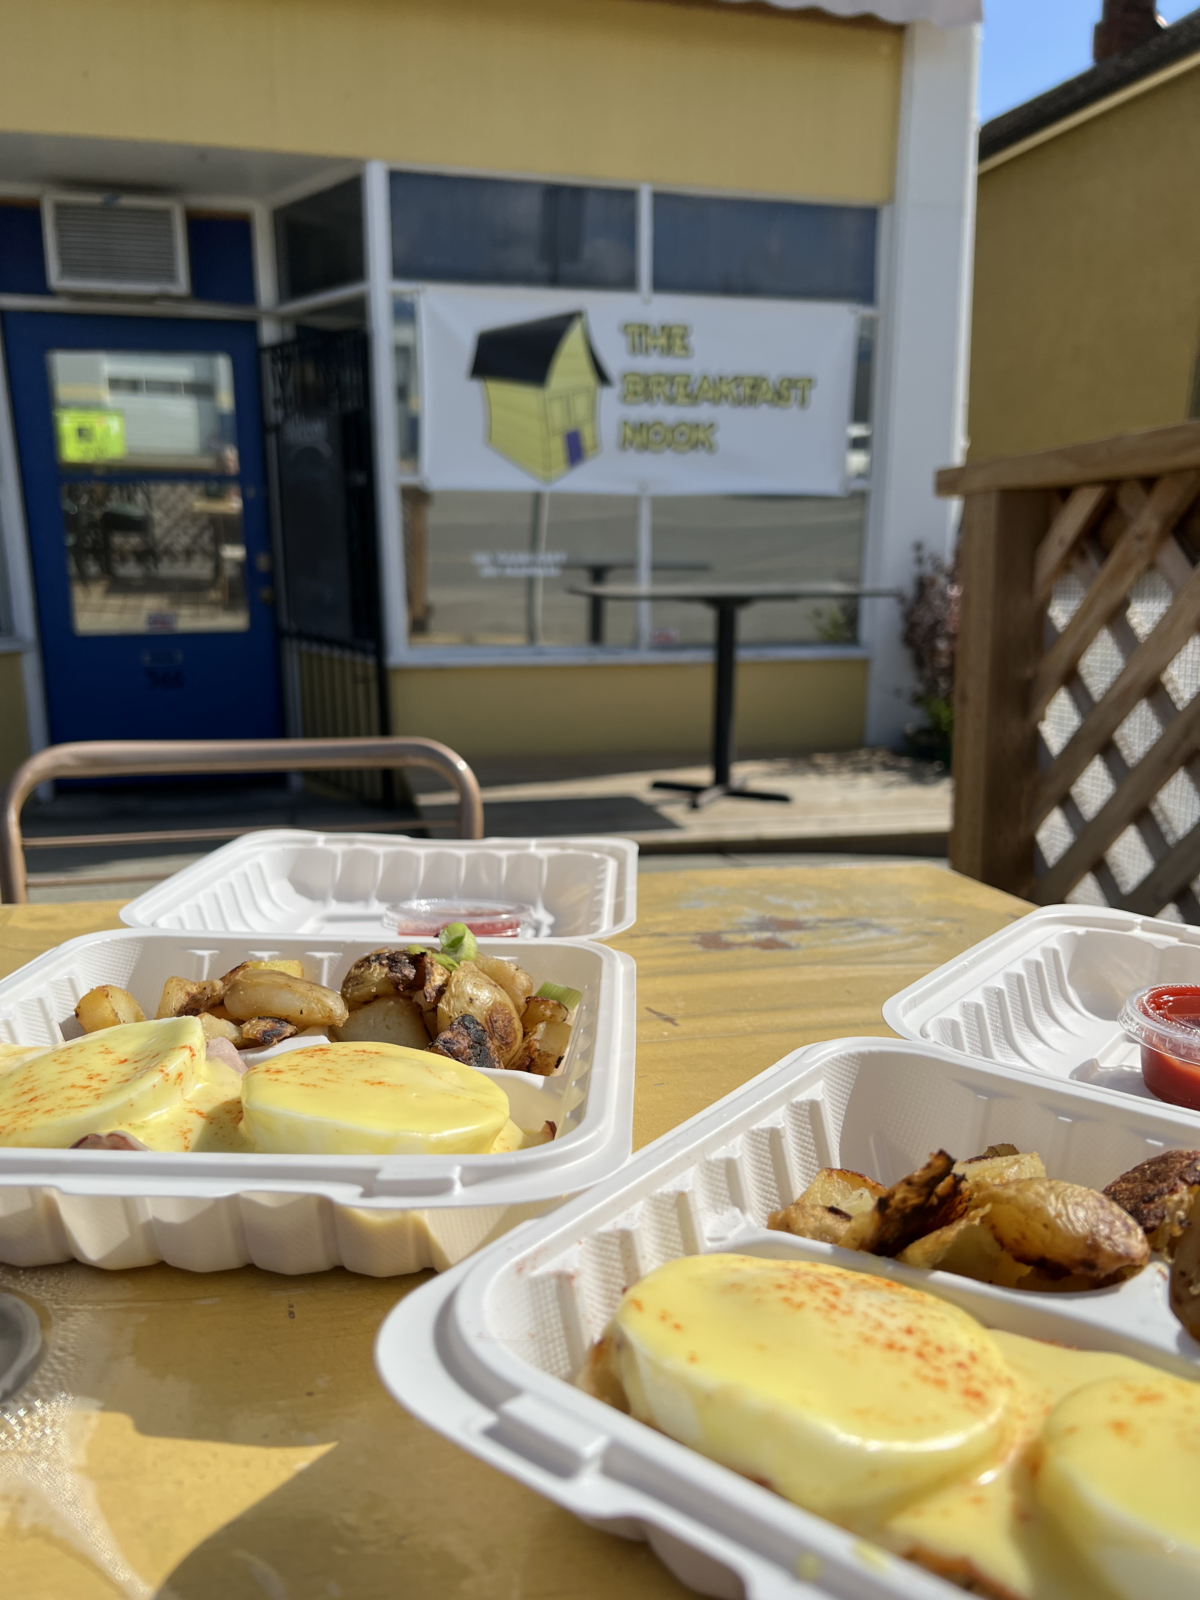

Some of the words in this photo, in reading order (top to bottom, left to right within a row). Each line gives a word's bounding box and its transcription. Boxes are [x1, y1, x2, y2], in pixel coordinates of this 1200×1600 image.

[621, 322, 692, 357] THE
[620, 371, 815, 409] BREAKFAST
[619, 419, 717, 454] NOOK
